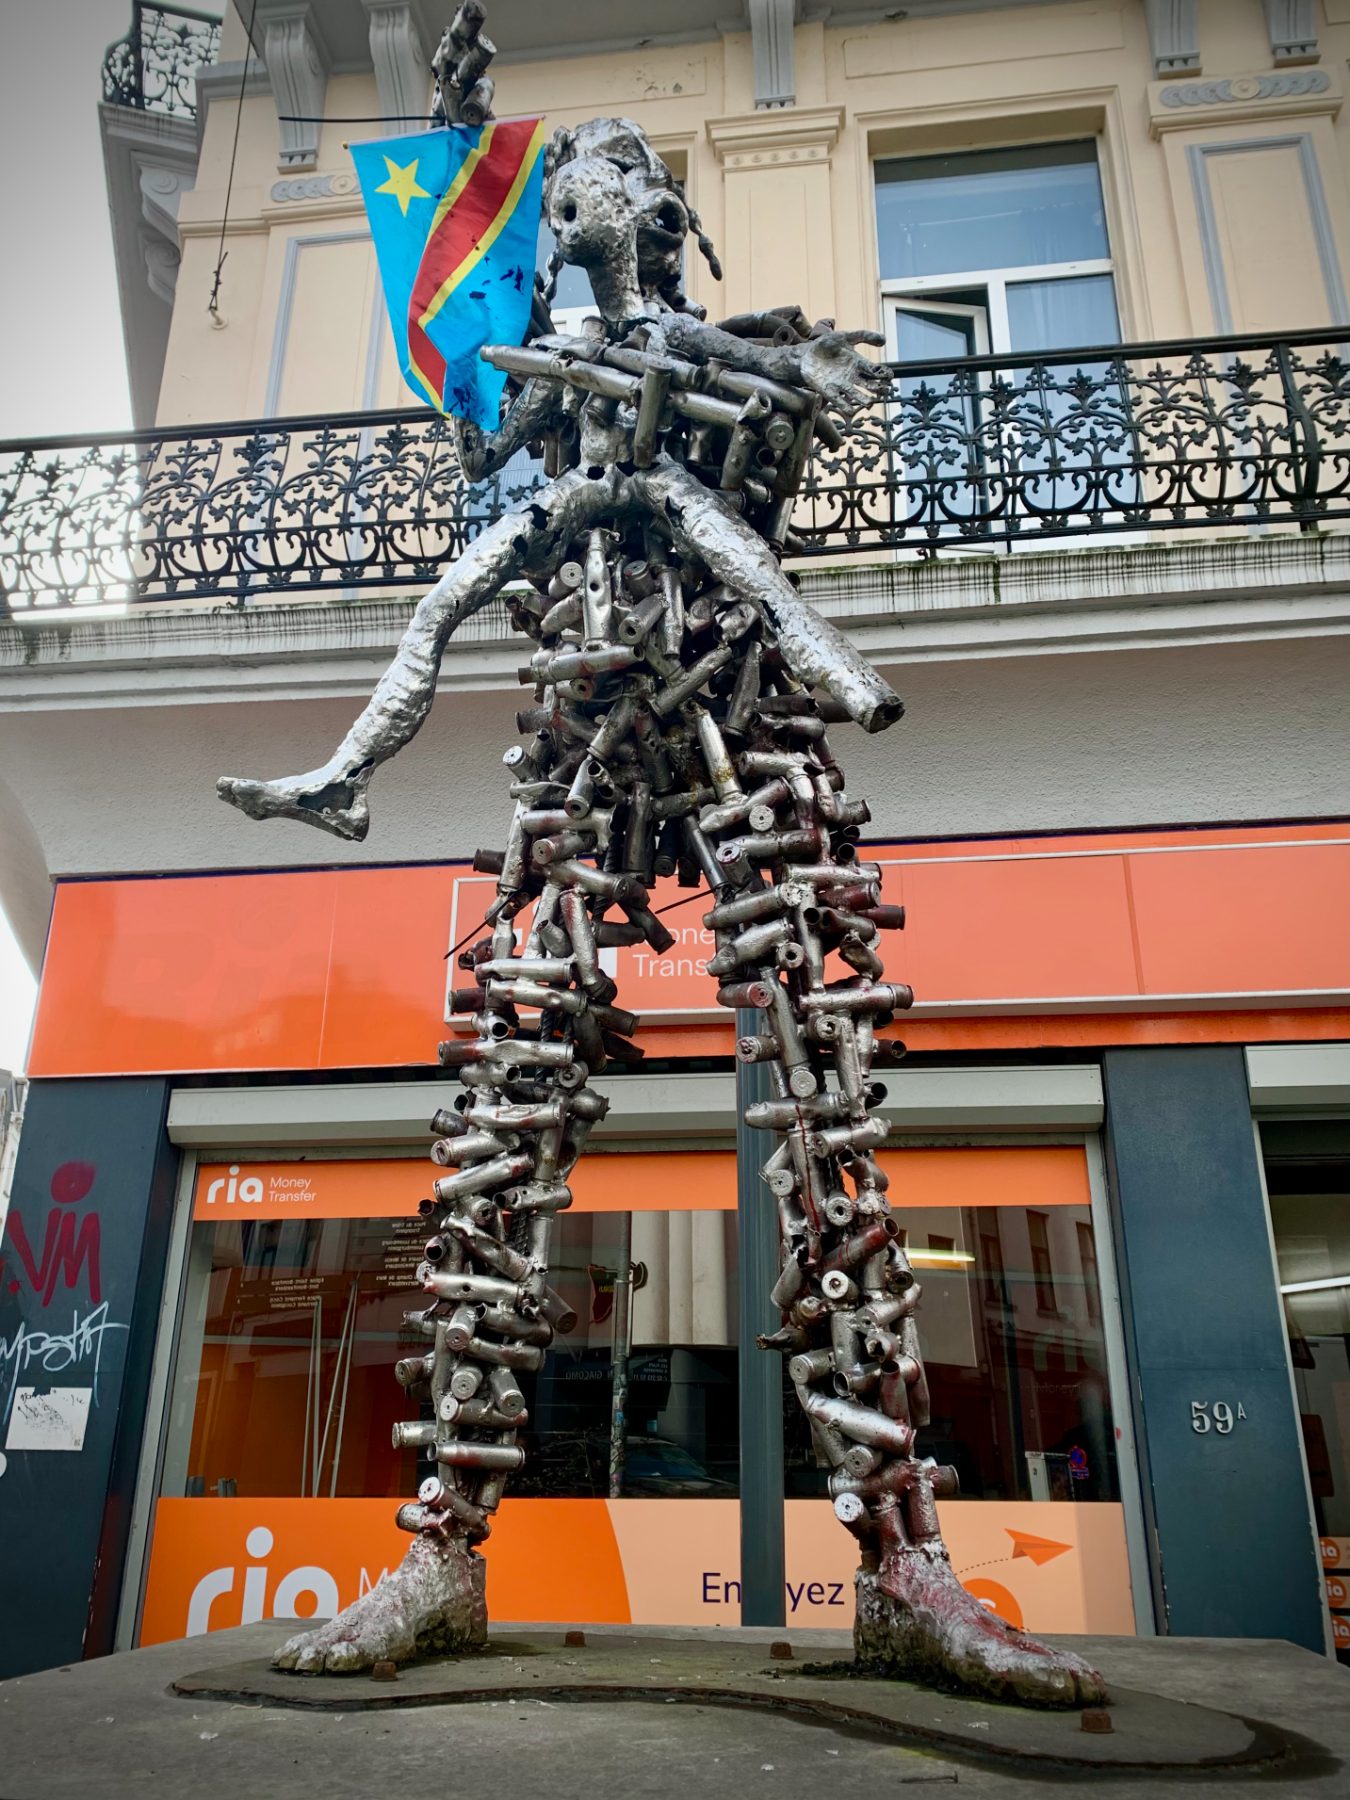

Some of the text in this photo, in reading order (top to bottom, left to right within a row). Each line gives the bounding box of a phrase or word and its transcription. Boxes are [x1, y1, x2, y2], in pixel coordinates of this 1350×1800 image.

[632, 953, 714, 977] Trans
[207, 1165, 264, 1203] ria
[268, 1190, 317, 1203] Transfer
[270, 1177, 312, 1190] Money
[186, 1526, 340, 1638] ria
[702, 1572, 845, 1612] Enyez
